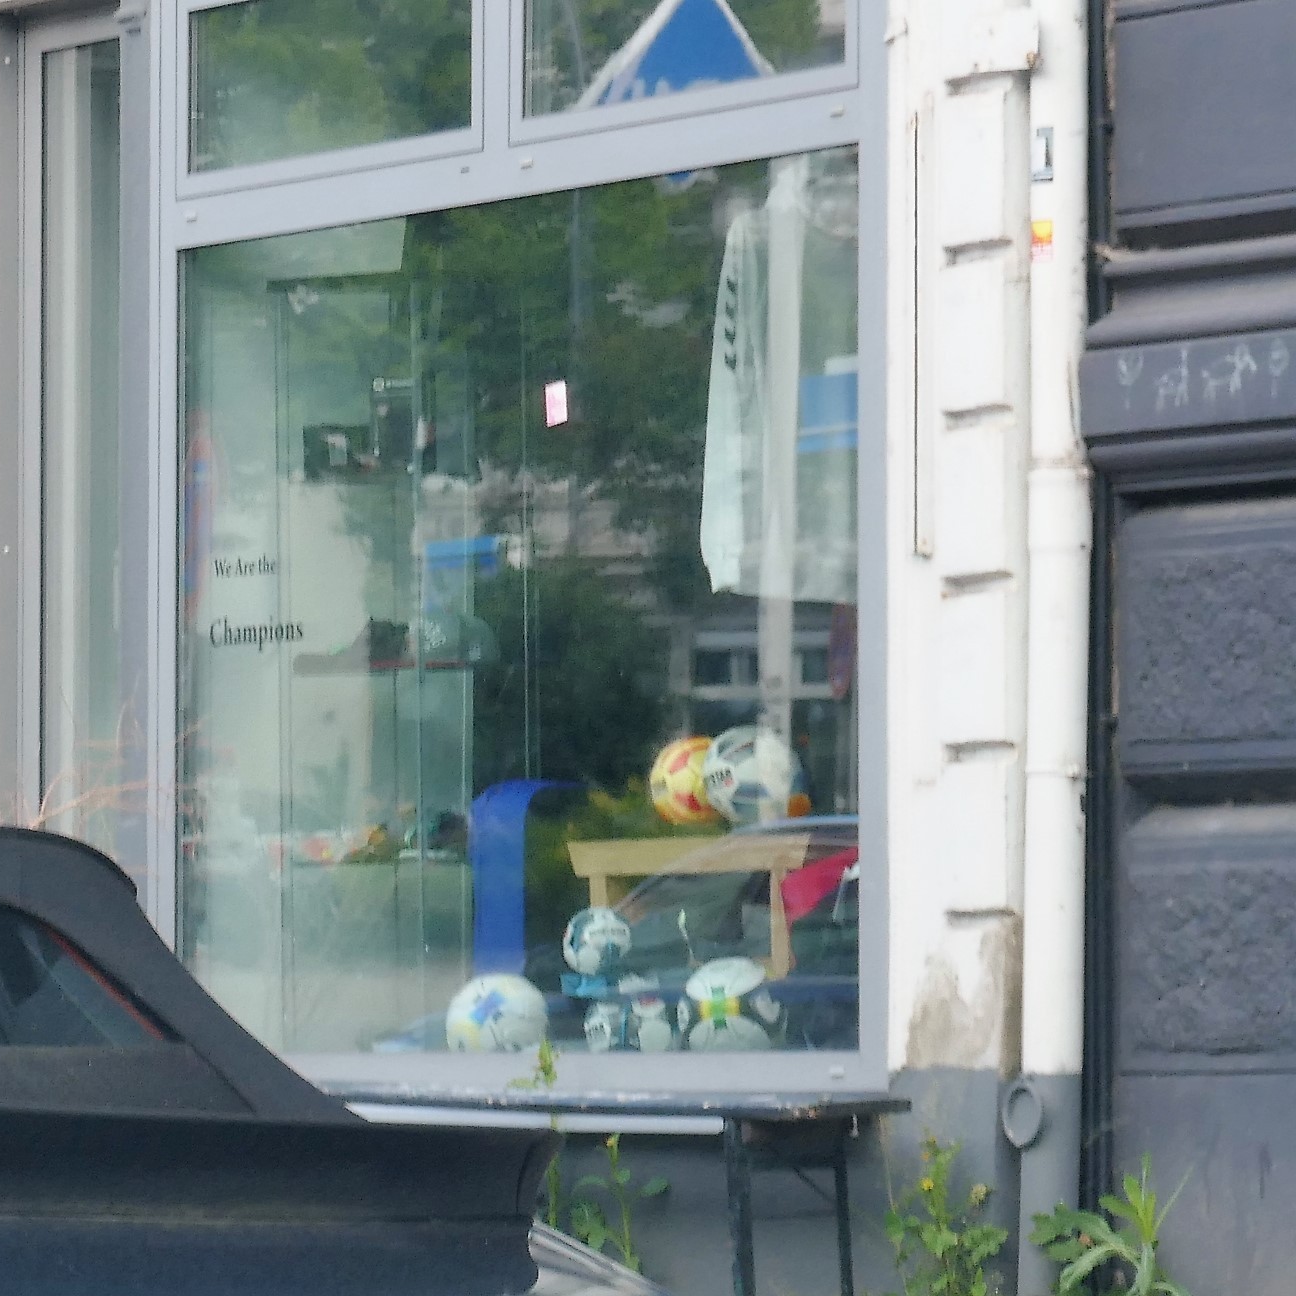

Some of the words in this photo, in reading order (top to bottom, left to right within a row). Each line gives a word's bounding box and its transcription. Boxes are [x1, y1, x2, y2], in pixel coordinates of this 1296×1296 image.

[214, 559, 232, 578] We
[236, 557, 255, 576] Are
[258, 553, 276, 576] the
[210, 615, 303, 651] Champions
